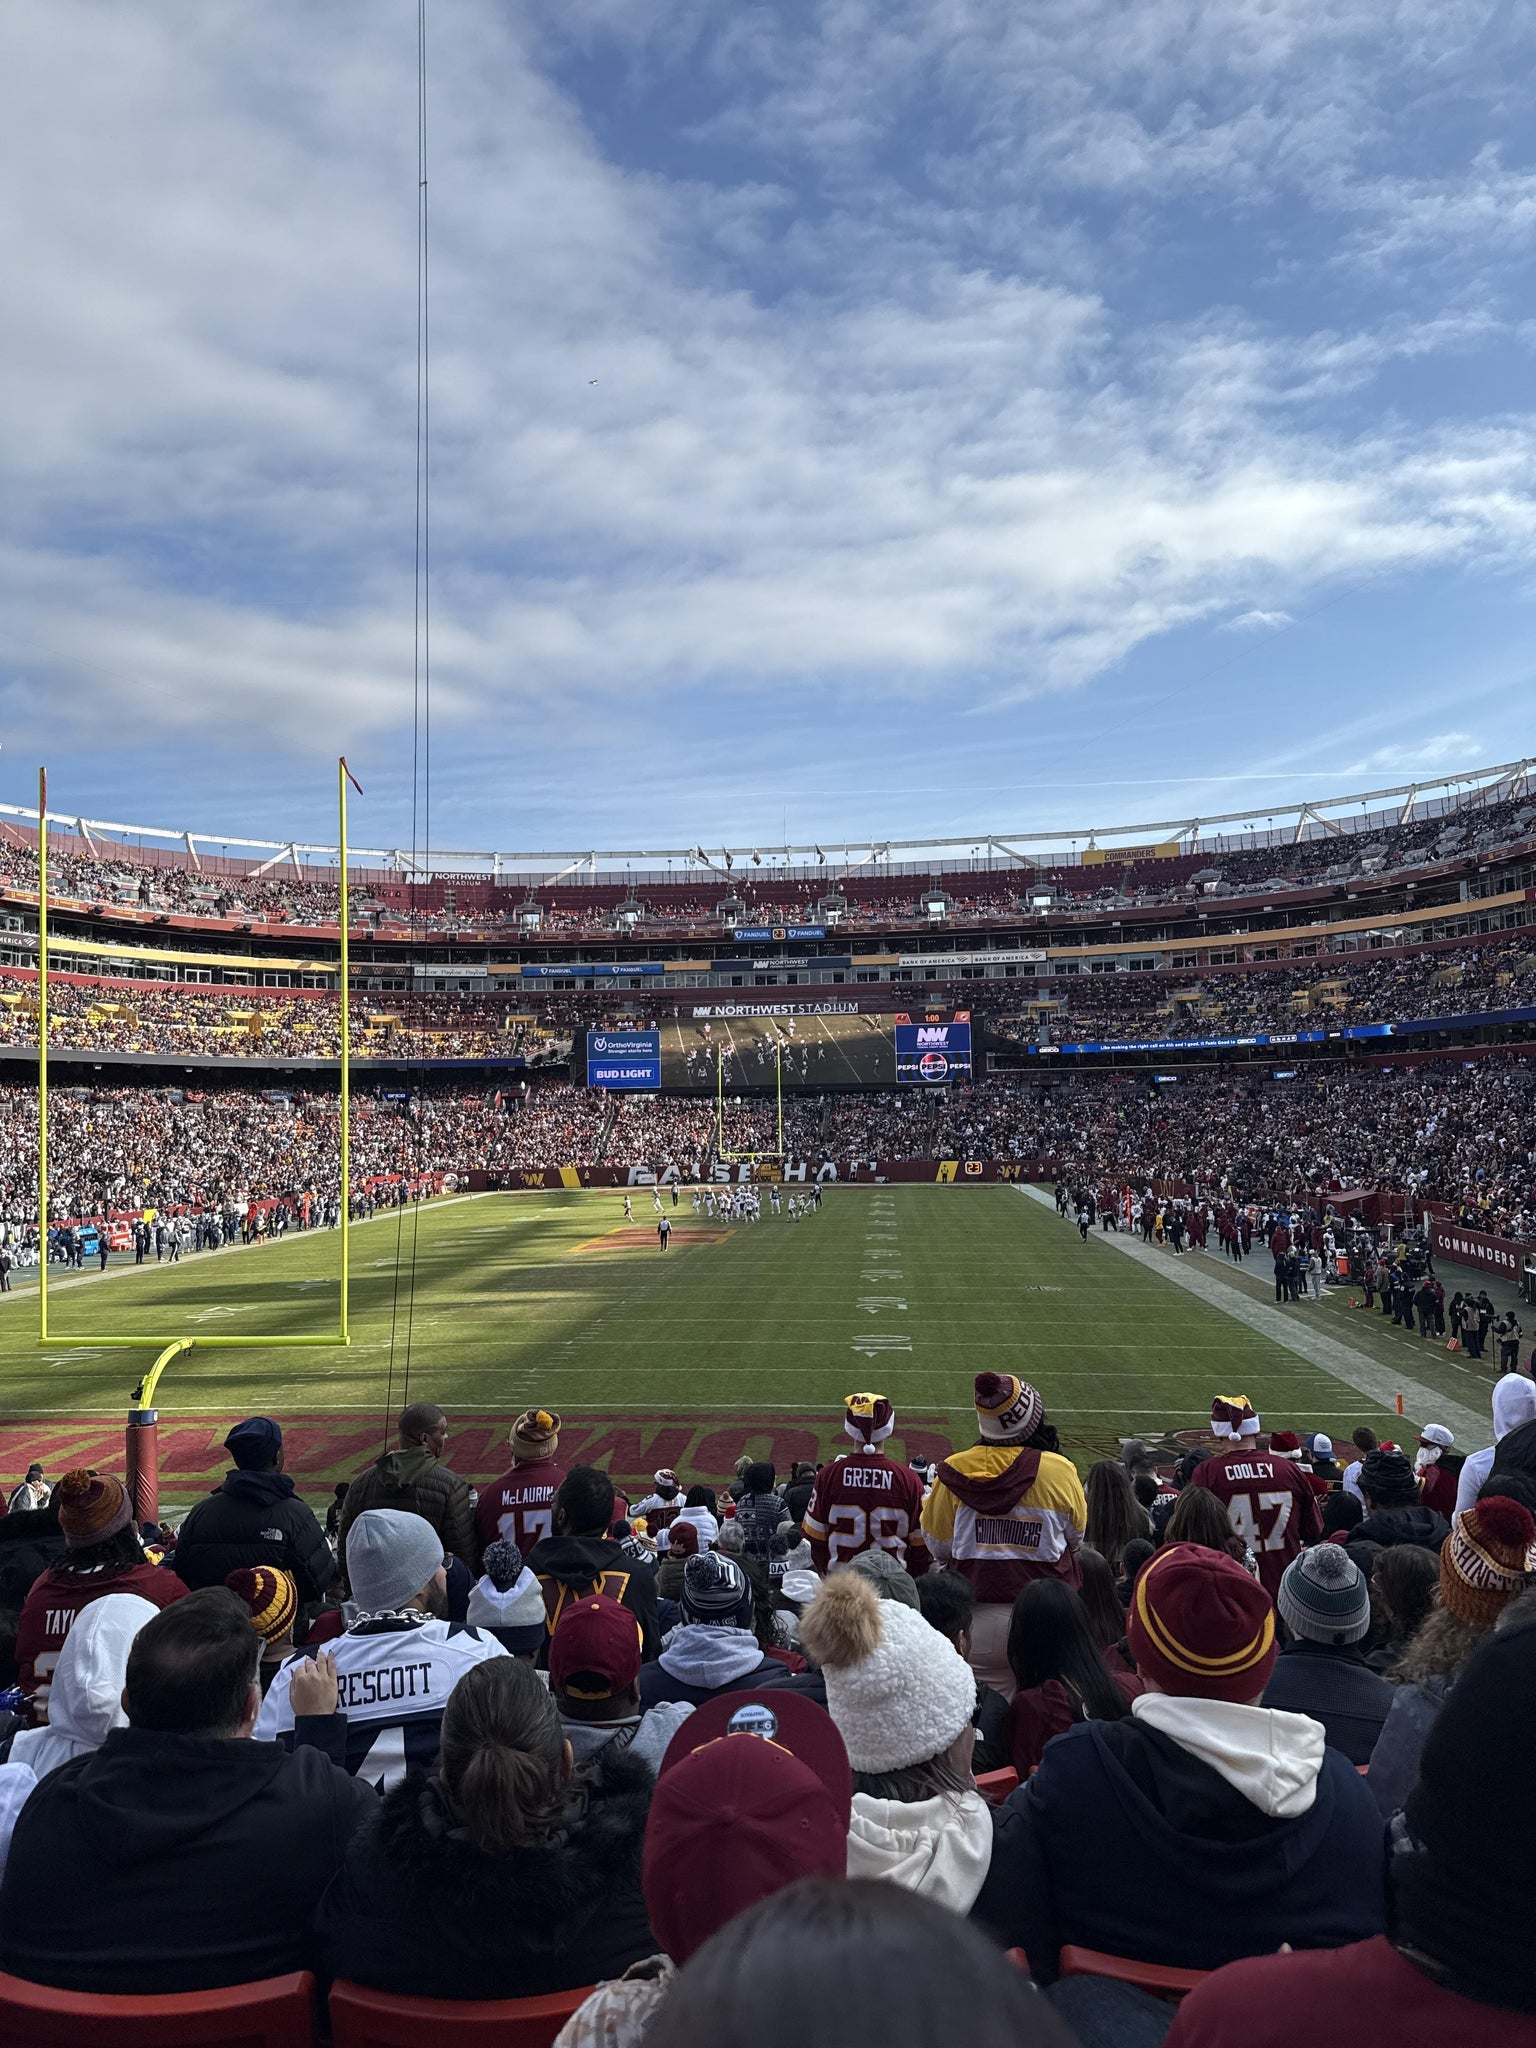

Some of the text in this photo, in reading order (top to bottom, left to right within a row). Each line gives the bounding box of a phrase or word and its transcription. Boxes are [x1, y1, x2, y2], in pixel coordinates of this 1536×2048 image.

[1104, 849, 1156, 861] COMMANDERS
[435, 872, 492, 881] NORTHWEST
[715, 1005, 796, 1015] NORTHWEST
[798, 1003, 859, 1013] STADIUM
[925, 1014, 940, 1022] 1:00
[608, 1041, 653, 1050] OrthoVirginia
[596, 1069, 652, 1079] BUD LIGHT
[966, 1163, 980, 1173] 23
[1438, 1234, 1516, 1268] COMMANDERS
[843, 1467, 893, 1490] GREEN
[1224, 1463, 1274, 1481] COOLEY
[502, 1486, 554, 1506] McLAURIN
[497, 1509, 553, 1546] 17
[1227, 1490, 1294, 1554] 47
[828, 1503, 910, 1573] 28
[975, 1518, 1043, 1548] COMMANDERS
[336, 1662, 432, 1709] RESCOTT
